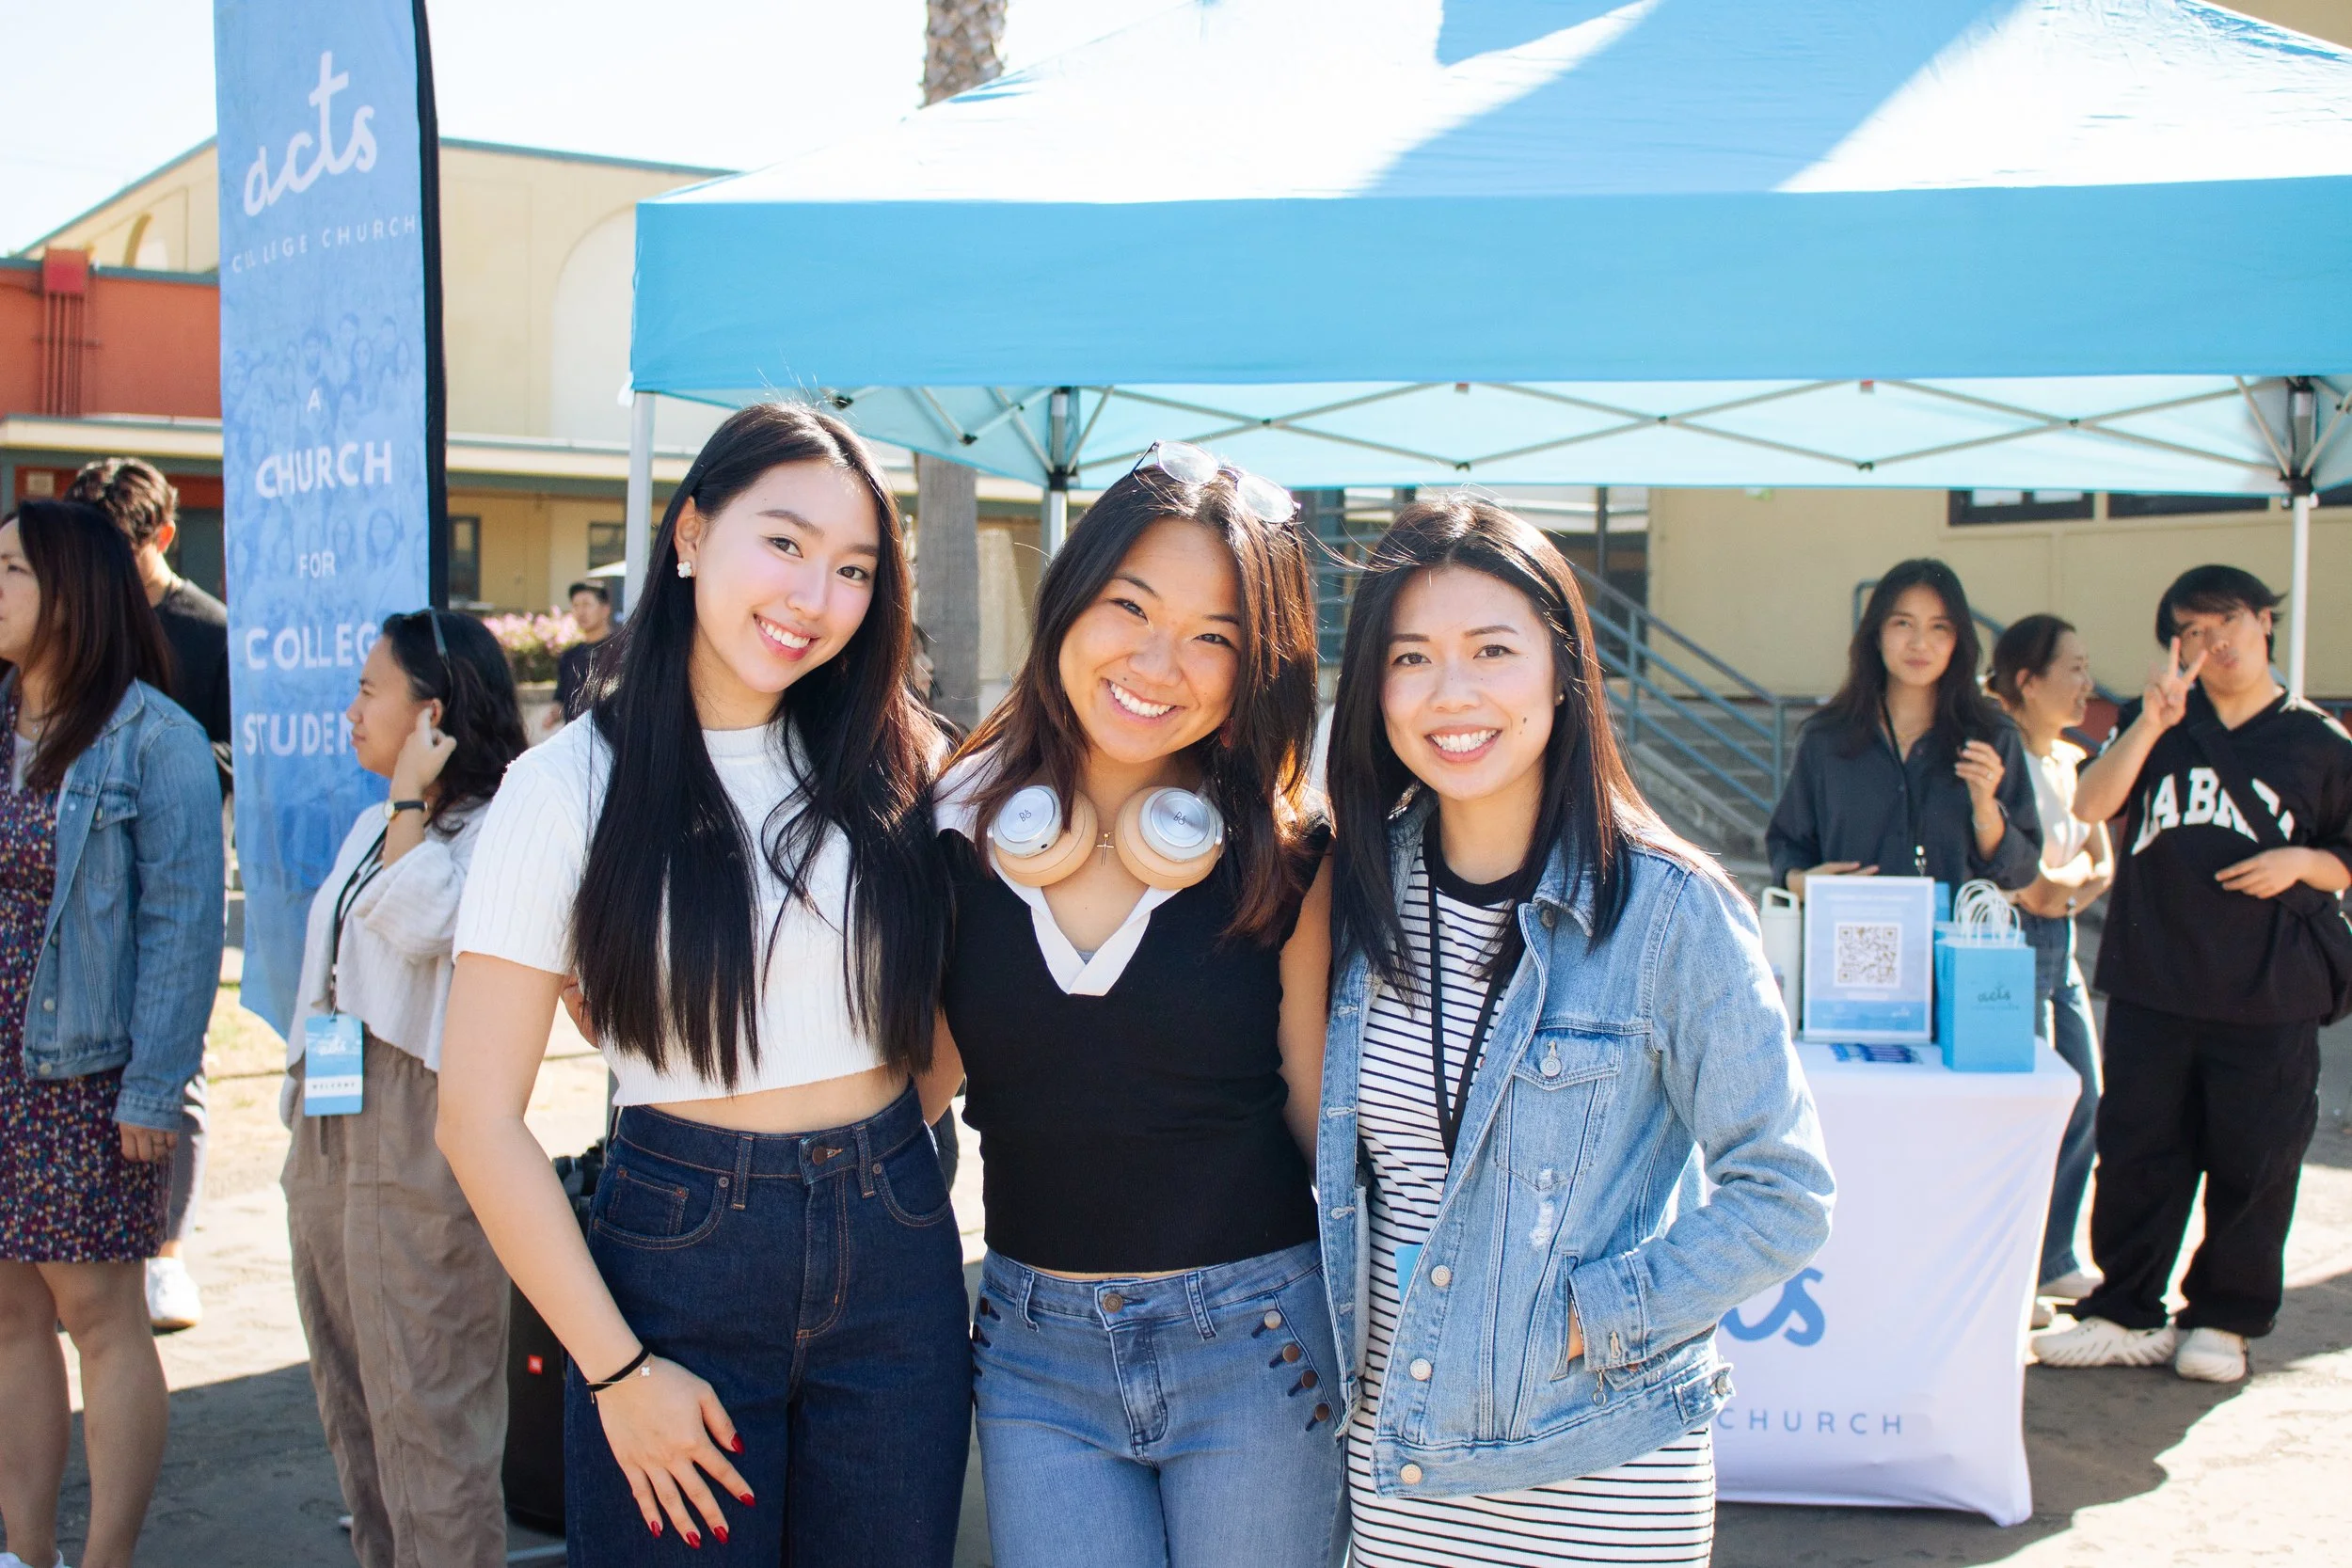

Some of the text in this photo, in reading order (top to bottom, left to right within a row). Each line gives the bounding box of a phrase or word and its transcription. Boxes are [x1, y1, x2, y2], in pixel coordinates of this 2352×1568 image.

[243, 50, 377, 216] acts
[322, 214, 417, 248] CHURCH
[307, 388, 321, 413] A
[255, 440, 391, 499] CHURCH
[298, 550, 336, 578] FOR
[246, 622, 377, 671] COLLEG
[243, 710, 355, 756] STUDEN
[1717, 1407, 1902, 1435] CHURCH
